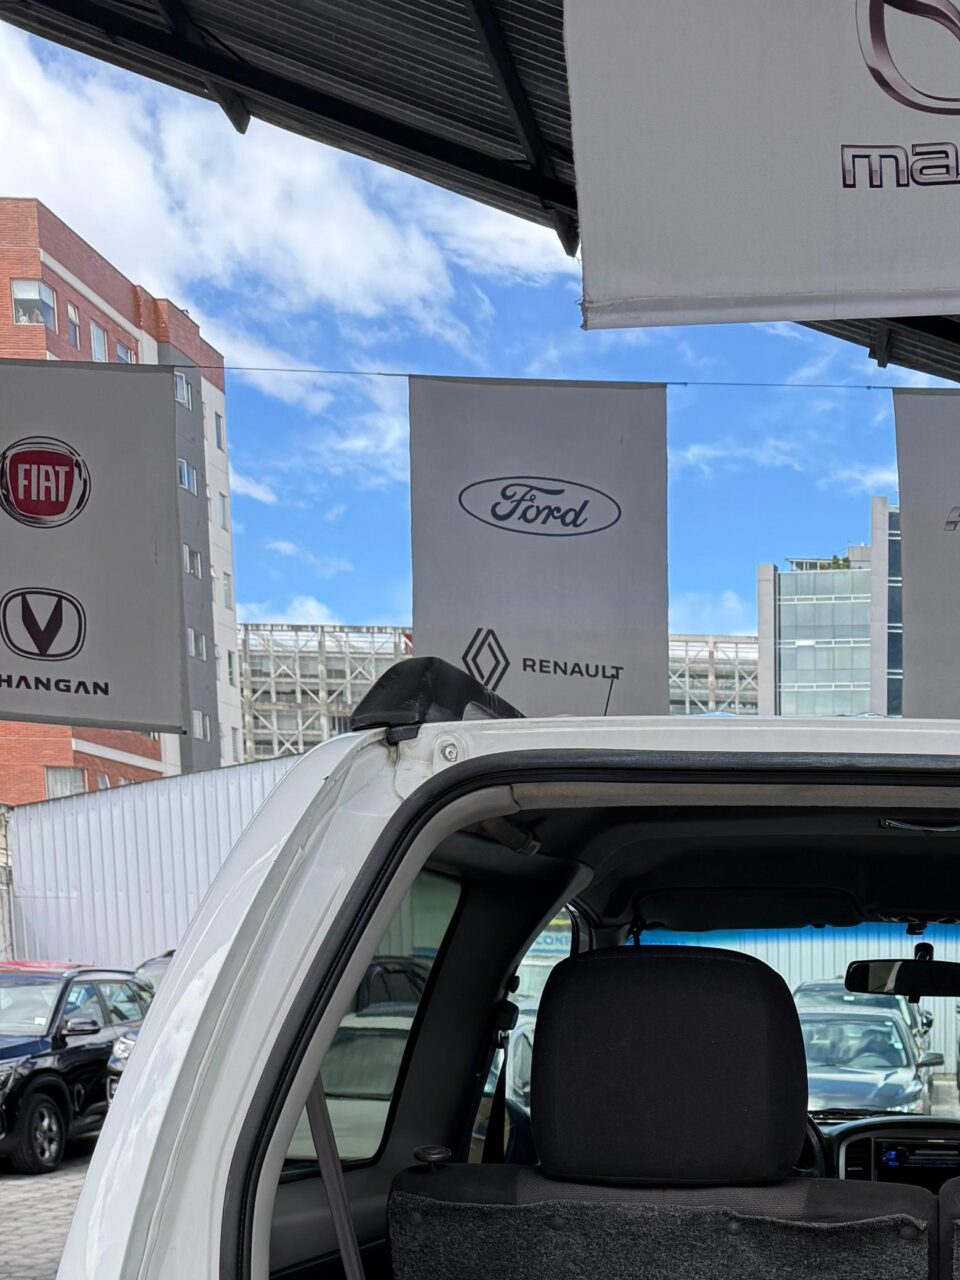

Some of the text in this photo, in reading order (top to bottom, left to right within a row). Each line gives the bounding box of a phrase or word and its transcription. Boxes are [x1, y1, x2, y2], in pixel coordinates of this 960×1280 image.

[17, 463, 70, 502] FIAT
[490, 483, 590, 528] Ford
[522, 657, 624, 680] RENAULT
